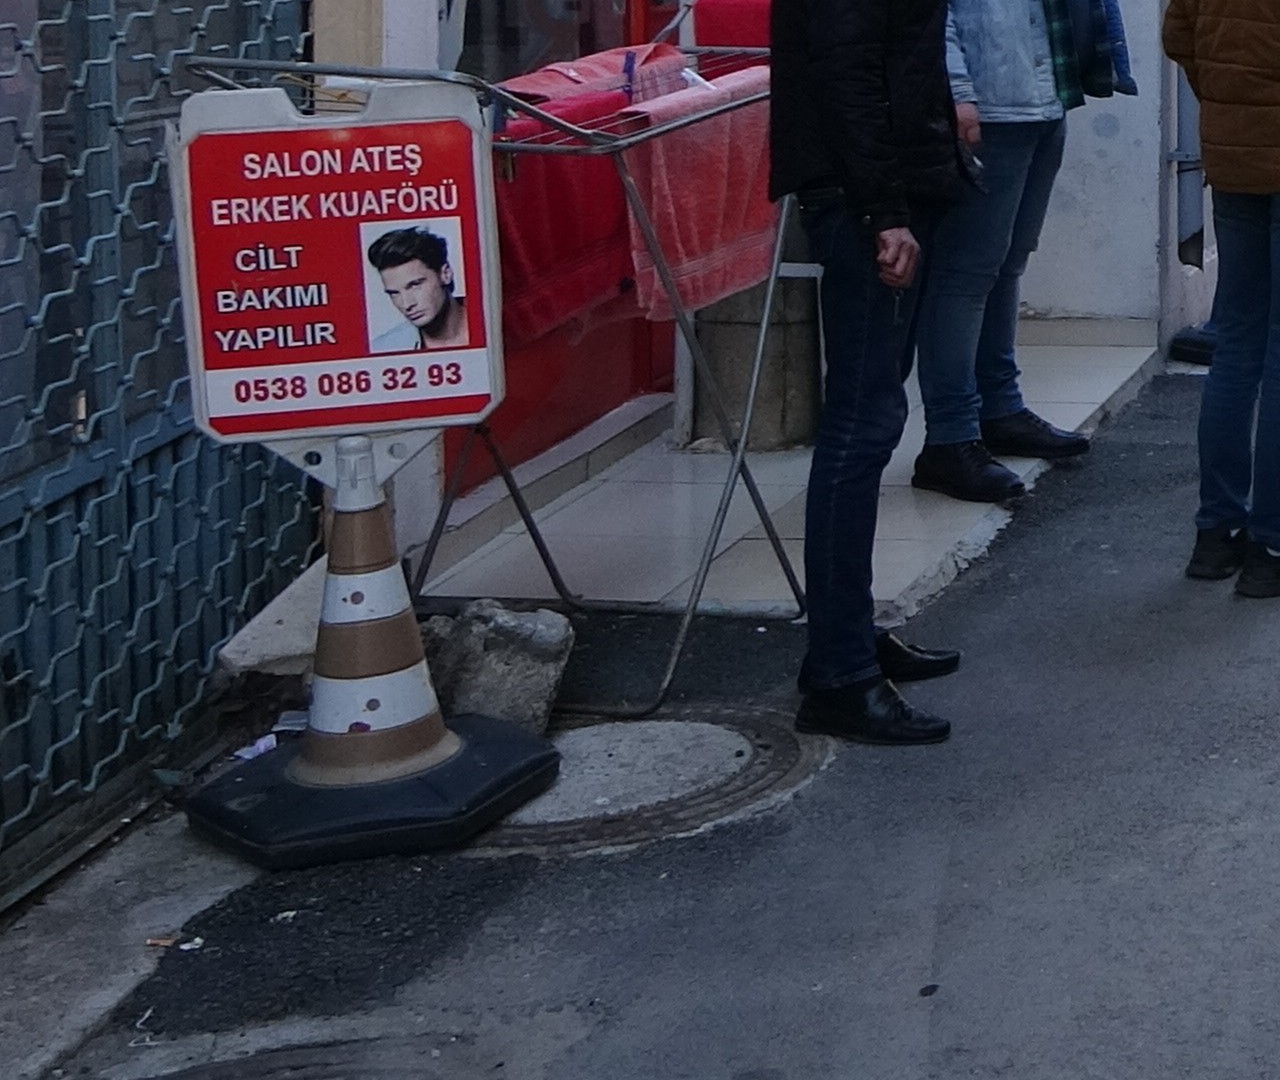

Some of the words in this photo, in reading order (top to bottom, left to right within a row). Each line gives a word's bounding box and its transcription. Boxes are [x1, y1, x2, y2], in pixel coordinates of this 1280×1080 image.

[243, 150, 342, 180] SALON
[349, 143, 423, 176] ATEŞ
[211, 196, 313, 226] ERKEK
[320, 178, 459, 219] KUAFÖRÜ
[234, 242, 303, 272] CİLT
[216, 283, 329, 314] BAKIMI
[213, 322, 336, 354] YAPILIR
[233, 375, 307, 404] 0538
[317, 370, 371, 396] 086
[382, 365, 417, 391] 32
[428, 362, 463, 387] 93
